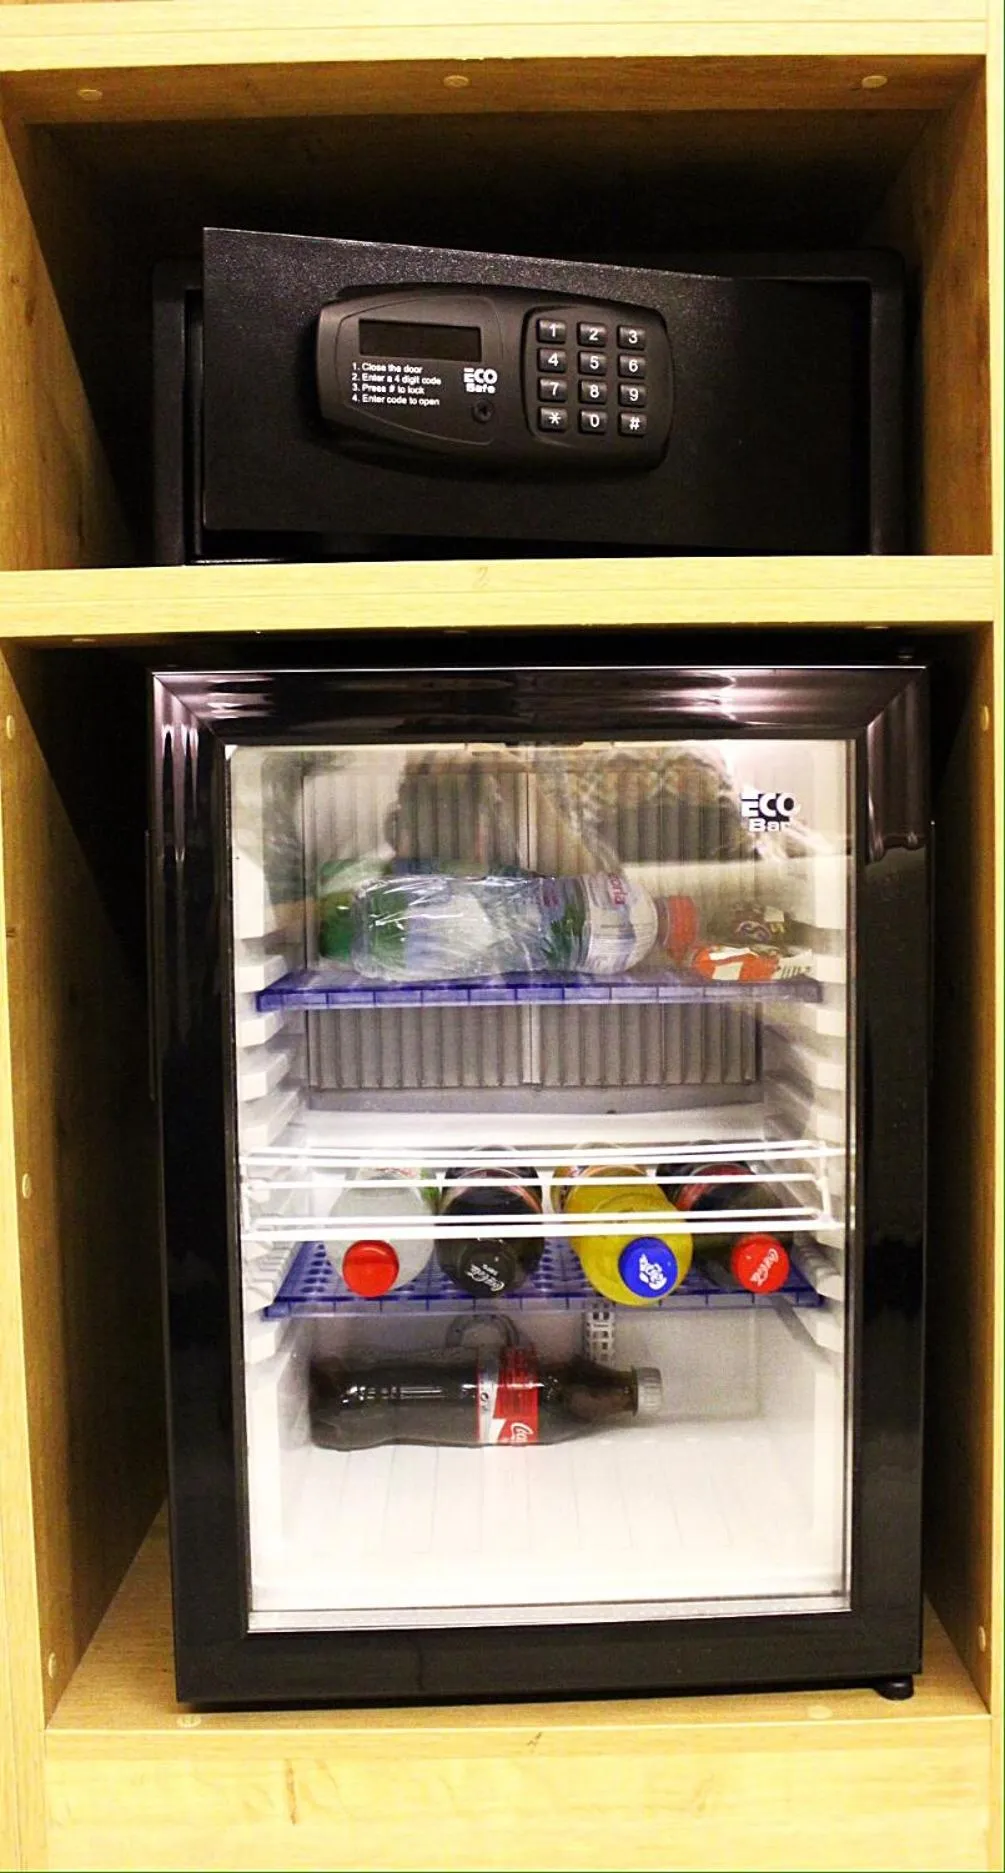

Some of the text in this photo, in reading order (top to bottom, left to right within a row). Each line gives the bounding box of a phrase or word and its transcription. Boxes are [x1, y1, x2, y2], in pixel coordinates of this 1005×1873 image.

[549, 322, 638, 344] 1 2 3
[352, 362, 423, 374] 1. Close the door
[548, 352, 638, 373] 4 5 6
[351, 373, 442, 385] 2. Enter a 4 digit code
[463, 367, 498, 384] ECO
[351, 383, 360, 391] 3.
[362, 384, 387, 393] Press
[398, 385, 406, 394] to
[407, 386, 425, 395] lock
[466, 382, 496, 394] Safe
[550, 382, 639, 402] 7 8 9
[351, 394, 440, 407] 4. Enter code to open
[590, 414, 600, 428] 0
[629, 416, 641, 431] #
[736, 787, 800, 817] ECO
